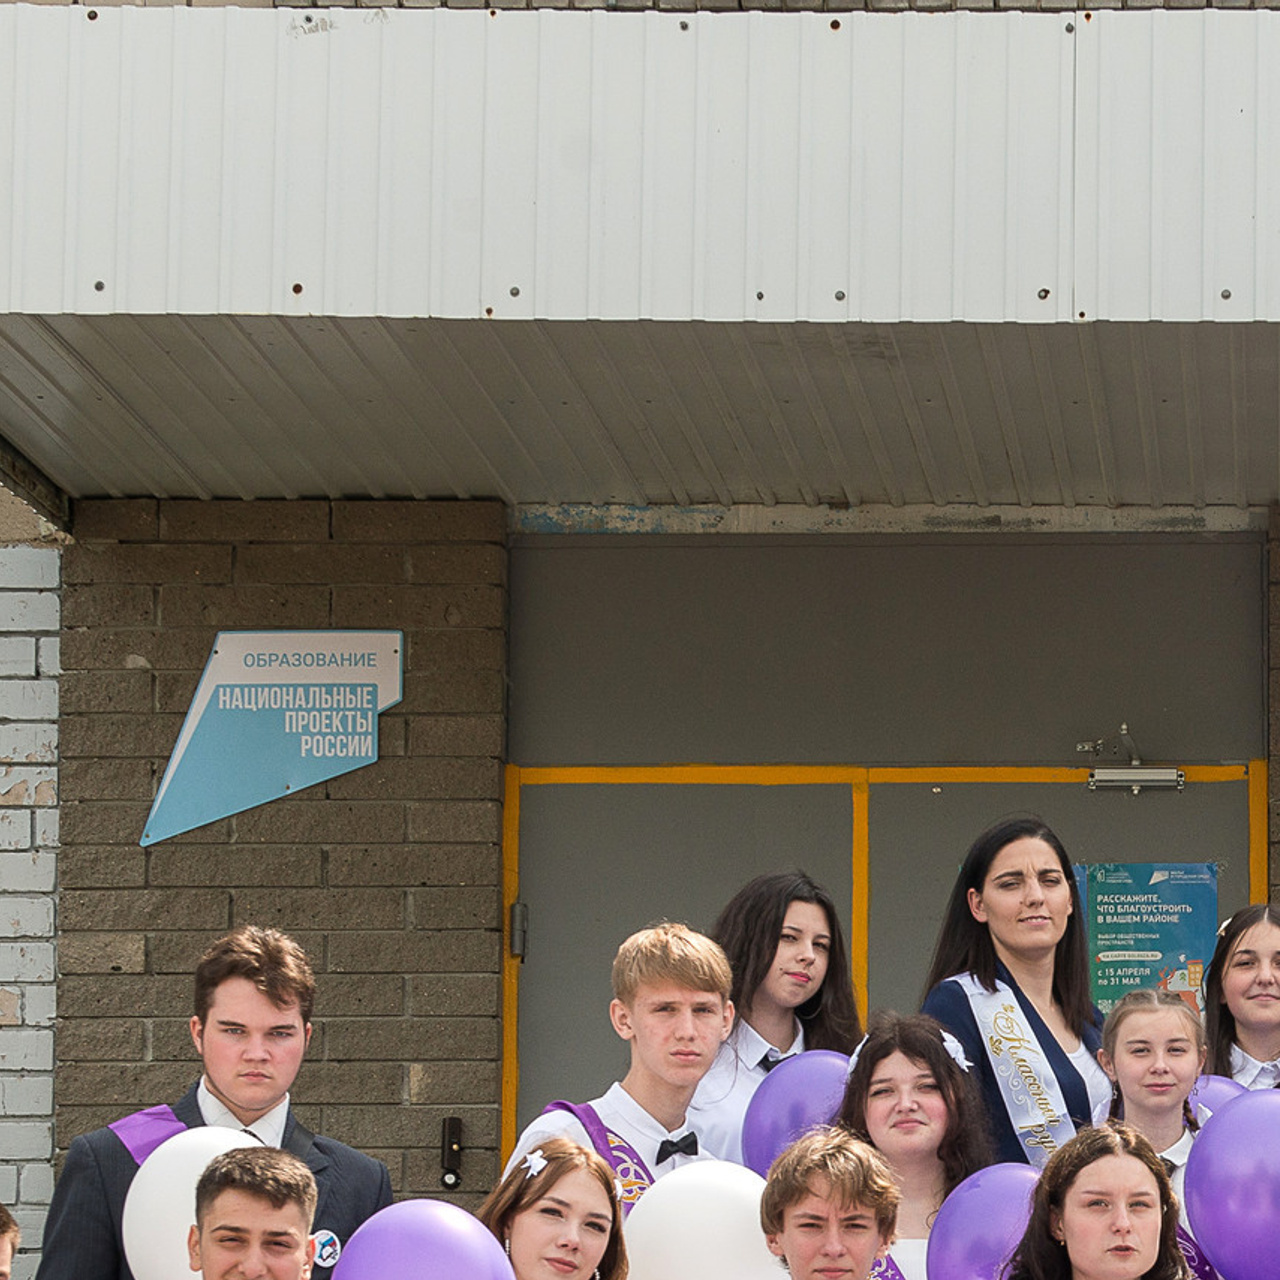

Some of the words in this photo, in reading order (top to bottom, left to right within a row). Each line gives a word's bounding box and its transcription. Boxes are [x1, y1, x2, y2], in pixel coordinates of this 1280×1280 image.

[243, 652, 377, 668] ОБРАЗОВАНИЕ
[218, 686, 373, 711] НАЦИОНАЛЬНЫЕ
[284, 711, 373, 733] ПРОЕКТЫ
[301, 735, 373, 757] РОССИИ
[1097, 894, 1161, 903] РАССКАЖИТЕ,
[1097, 904, 1114, 913] ЧТО
[1117, 904, 1193, 913] БЛАГОУСТРОИТЬ
[1097, 915, 1104, 923] В
[1106, 915, 1140, 923] ВАШЕМ
[1143, 914, 1179, 923] РАЙОНЕ
[1105, 968, 1114, 976] 15
[1117, 968, 1150, 976] АПРЕЛЯ
[1110, 977, 1119, 985] 31
[1122, 977, 1141, 985] МАЯ
